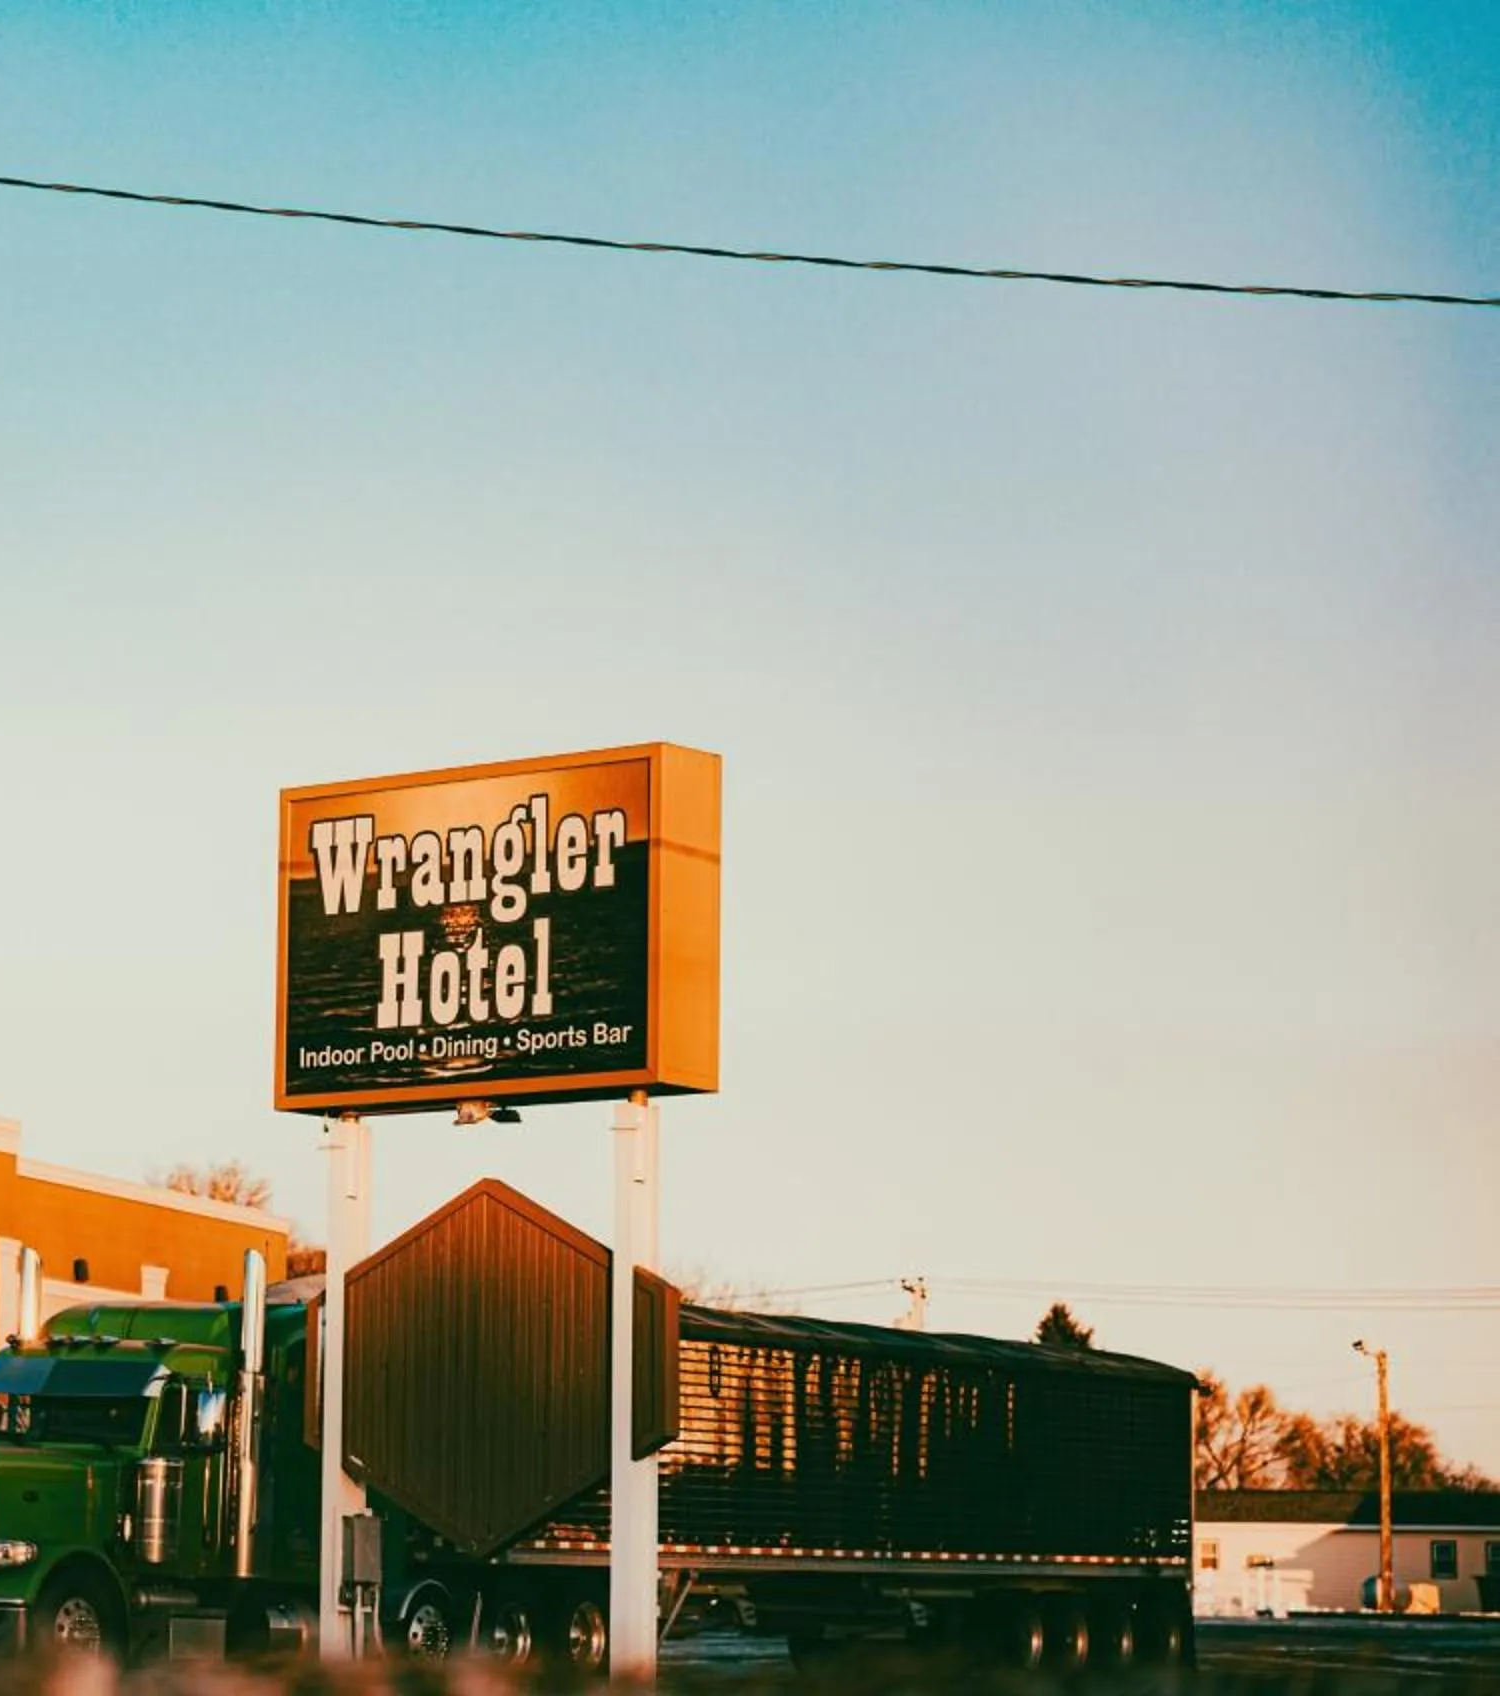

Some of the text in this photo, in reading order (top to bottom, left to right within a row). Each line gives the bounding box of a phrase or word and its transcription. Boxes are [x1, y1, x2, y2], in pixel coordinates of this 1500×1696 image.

[312, 794, 626, 922] Wrangler
[377, 917, 554, 1029] Hotel
[300, 1022, 633, 1068] Indoor Pool Dining Sports Bar
